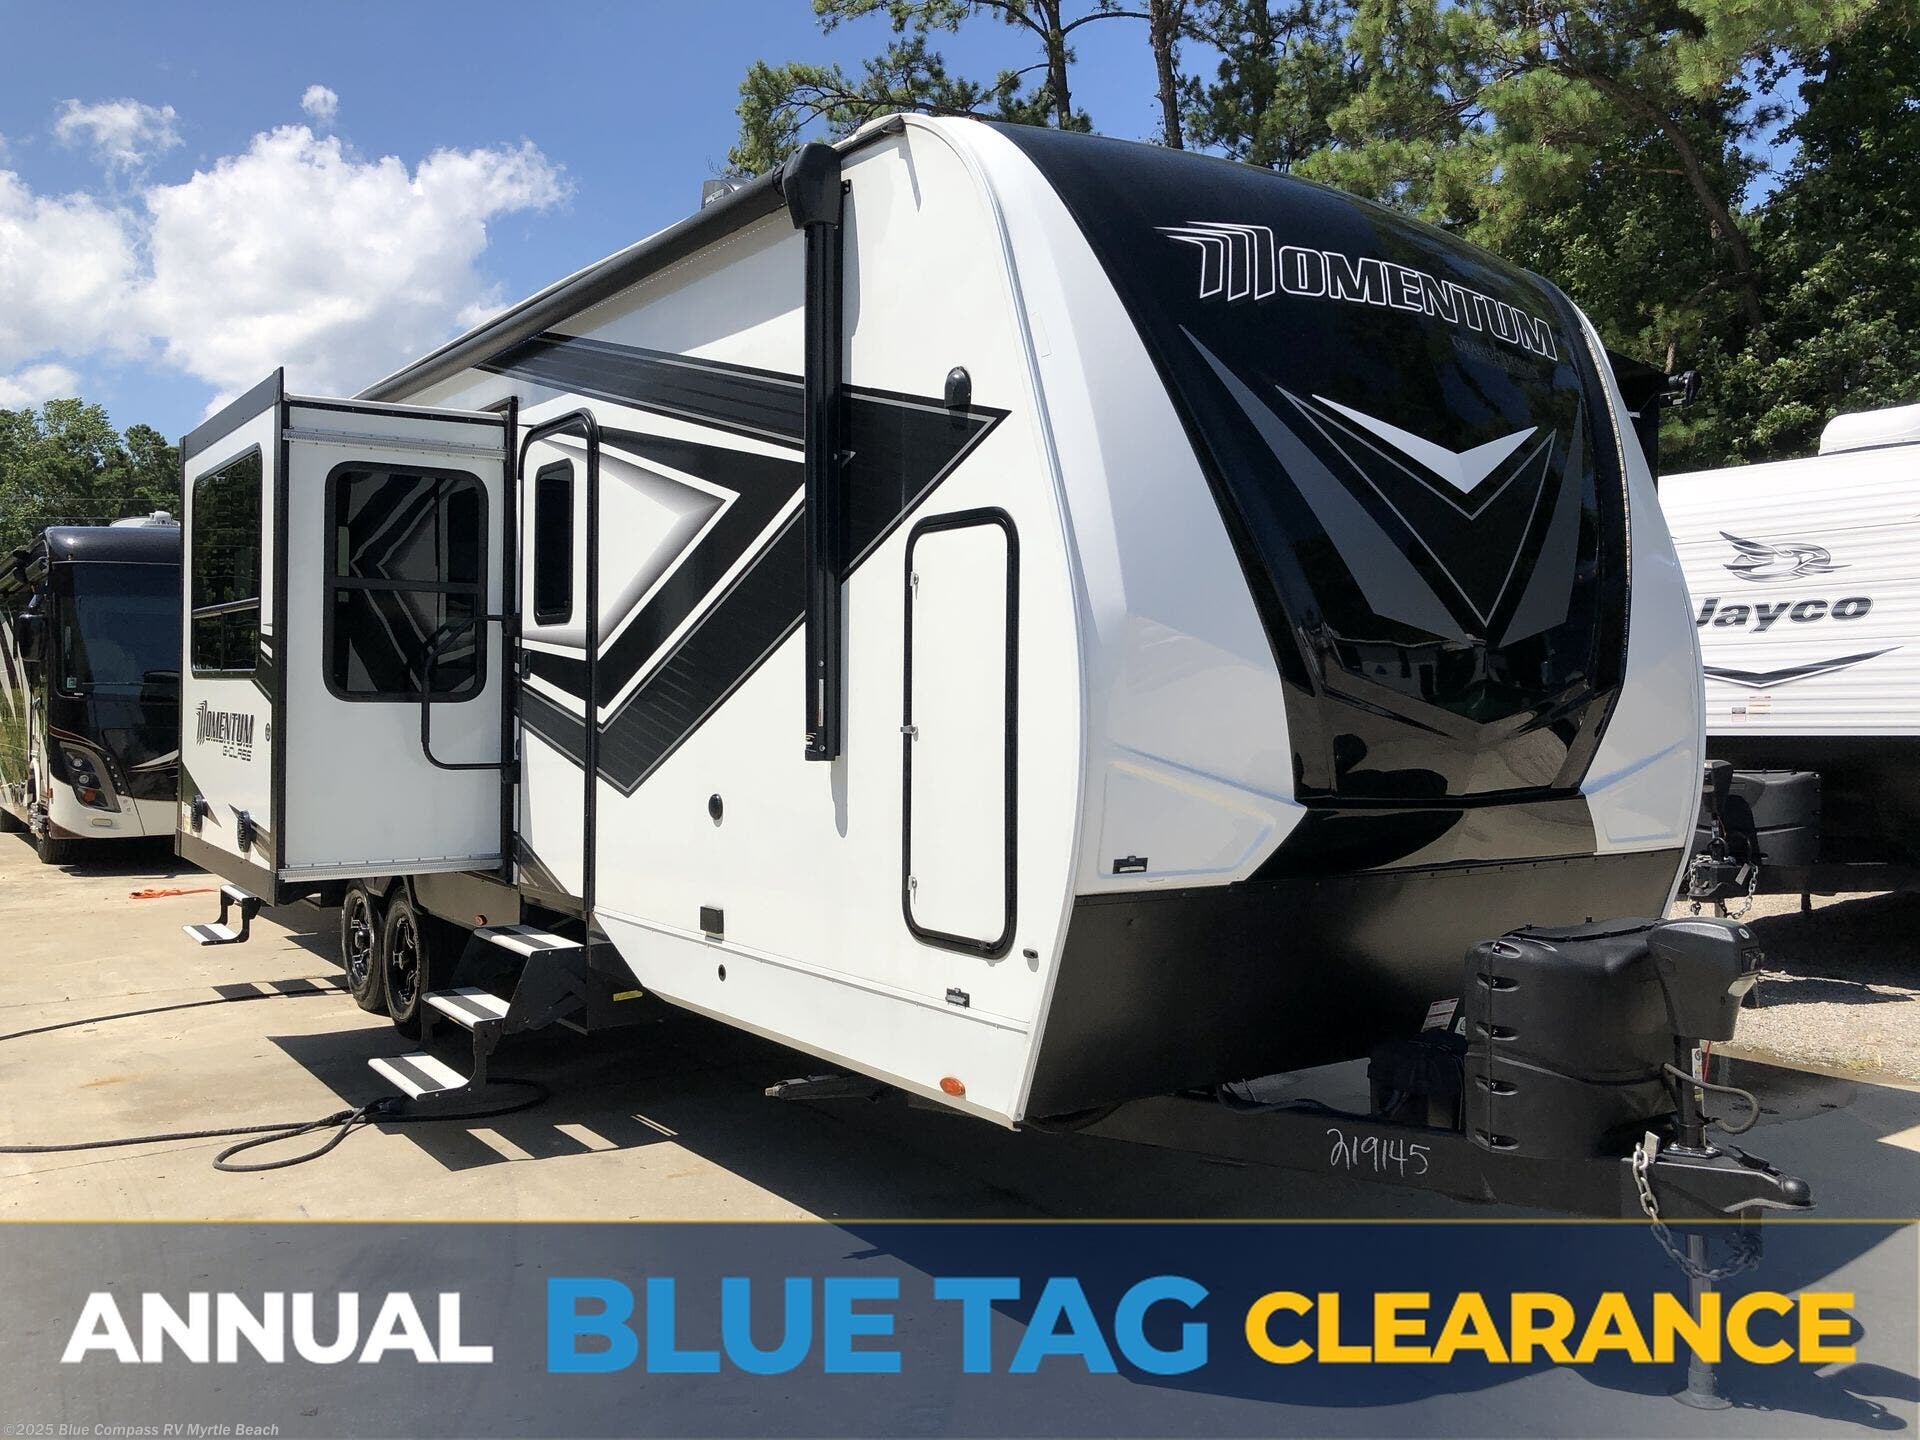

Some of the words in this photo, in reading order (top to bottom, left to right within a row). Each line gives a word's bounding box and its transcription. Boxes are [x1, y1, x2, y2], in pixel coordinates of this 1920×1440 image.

[1154, 220, 1558, 361] MOMENTUM
[1696, 597, 1873, 633] Jayco
[195, 700, 254, 748] MOMENTUM
[1327, 1128, 1430, 1177] 219145
